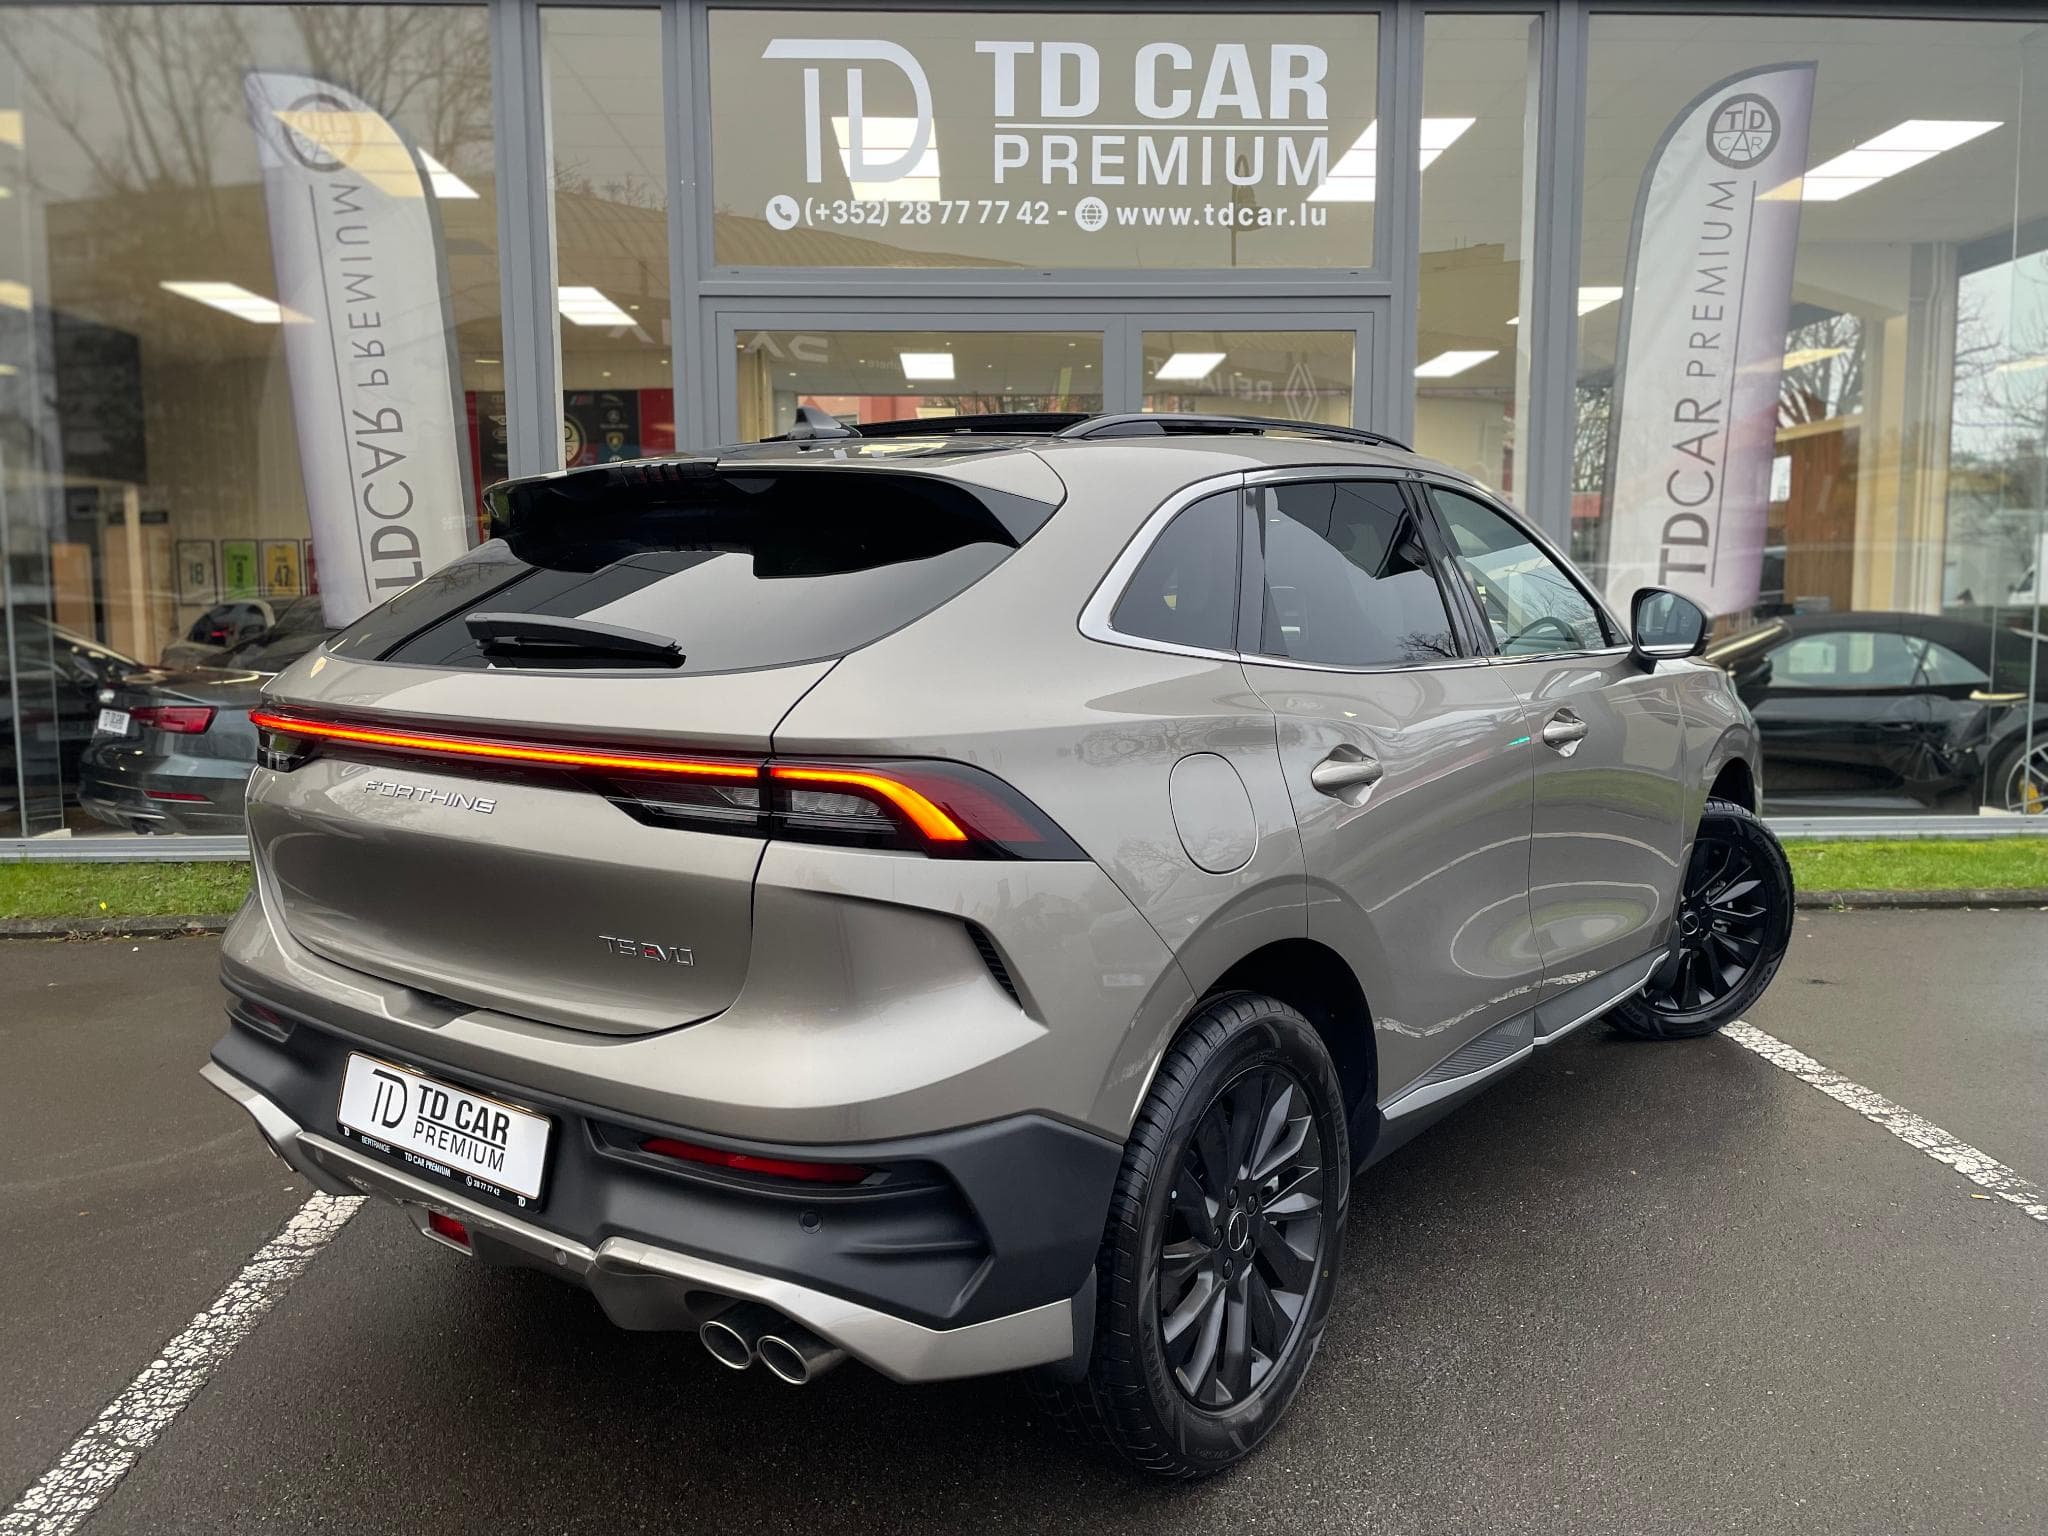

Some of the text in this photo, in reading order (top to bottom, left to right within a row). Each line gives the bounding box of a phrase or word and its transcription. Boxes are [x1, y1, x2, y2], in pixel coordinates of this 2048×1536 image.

[975, 41, 1329, 120] TD CAR
[1725, 109, 1766, 130] TD
[994, 134, 1329, 186] PREMIUM
[1718, 131, 1763, 160] CAR
[805, 196, 890, 227] (+352)
[900, 200, 932, 225] 28
[938, 200, 971, 225] 77
[977, 200, 1010, 225] 77
[1016, 200, 1050, 225] 42
[1116, 201, 1328, 226] www.tdcar.lu
[1685, 180, 1738, 378] PREMIUM
[363, 780, 497, 814] FORTHING
[419, 1083, 510, 1146] TD CAR
[404, 1152, 451, 1178] TD CAR PREMIUM
[413, 1120, 505, 1173] PREMIUM
